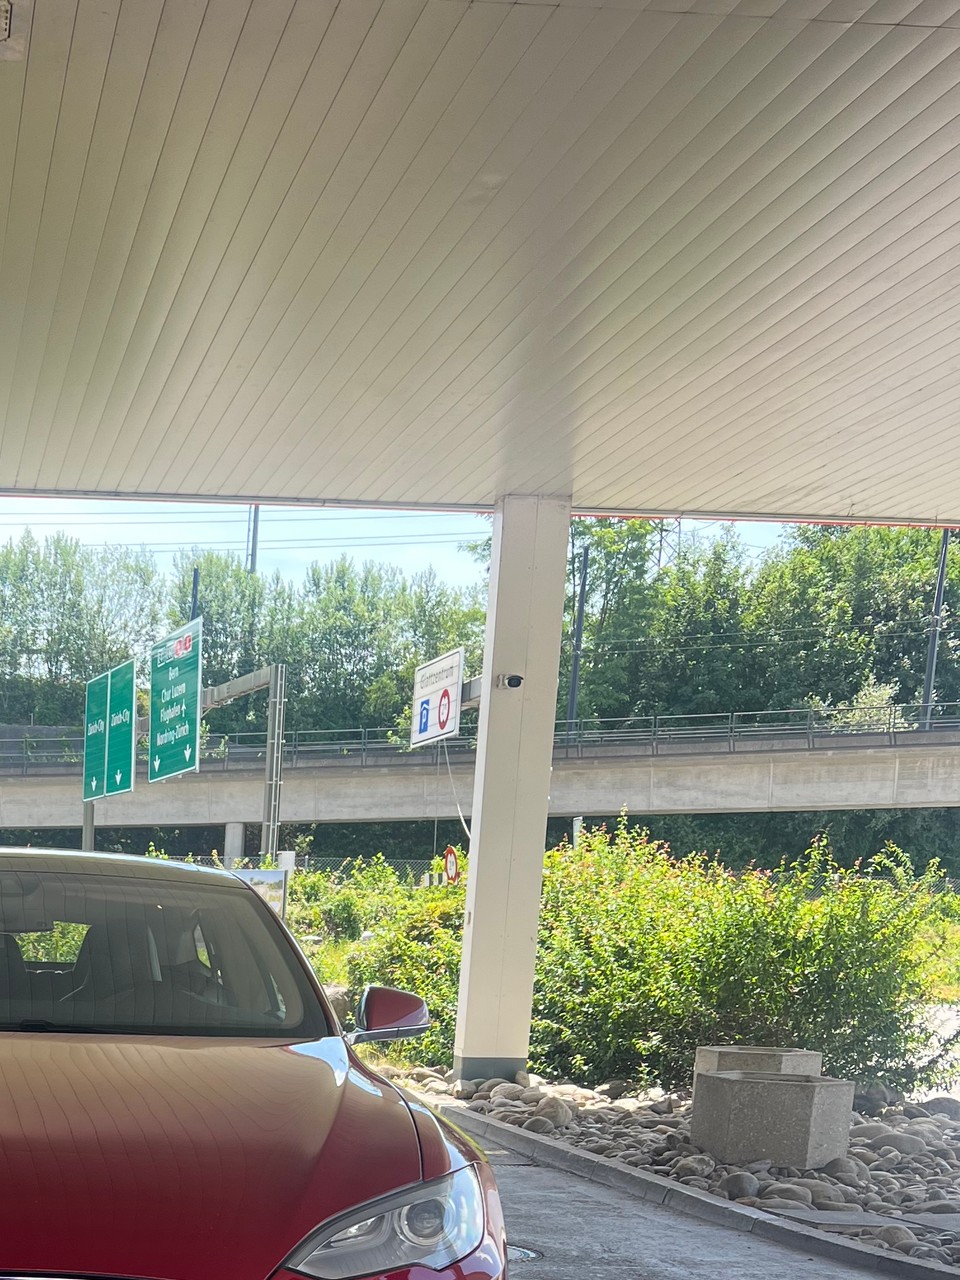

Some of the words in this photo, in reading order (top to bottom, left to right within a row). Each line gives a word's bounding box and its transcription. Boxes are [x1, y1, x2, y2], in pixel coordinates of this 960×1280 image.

[111, 708, 130, 727] Zürich-City
[160, 703, 181, 723] Flughafen
[87, 719, 105, 736] Zürich-City
[157, 721, 189, 745] Nordring-Zürich
